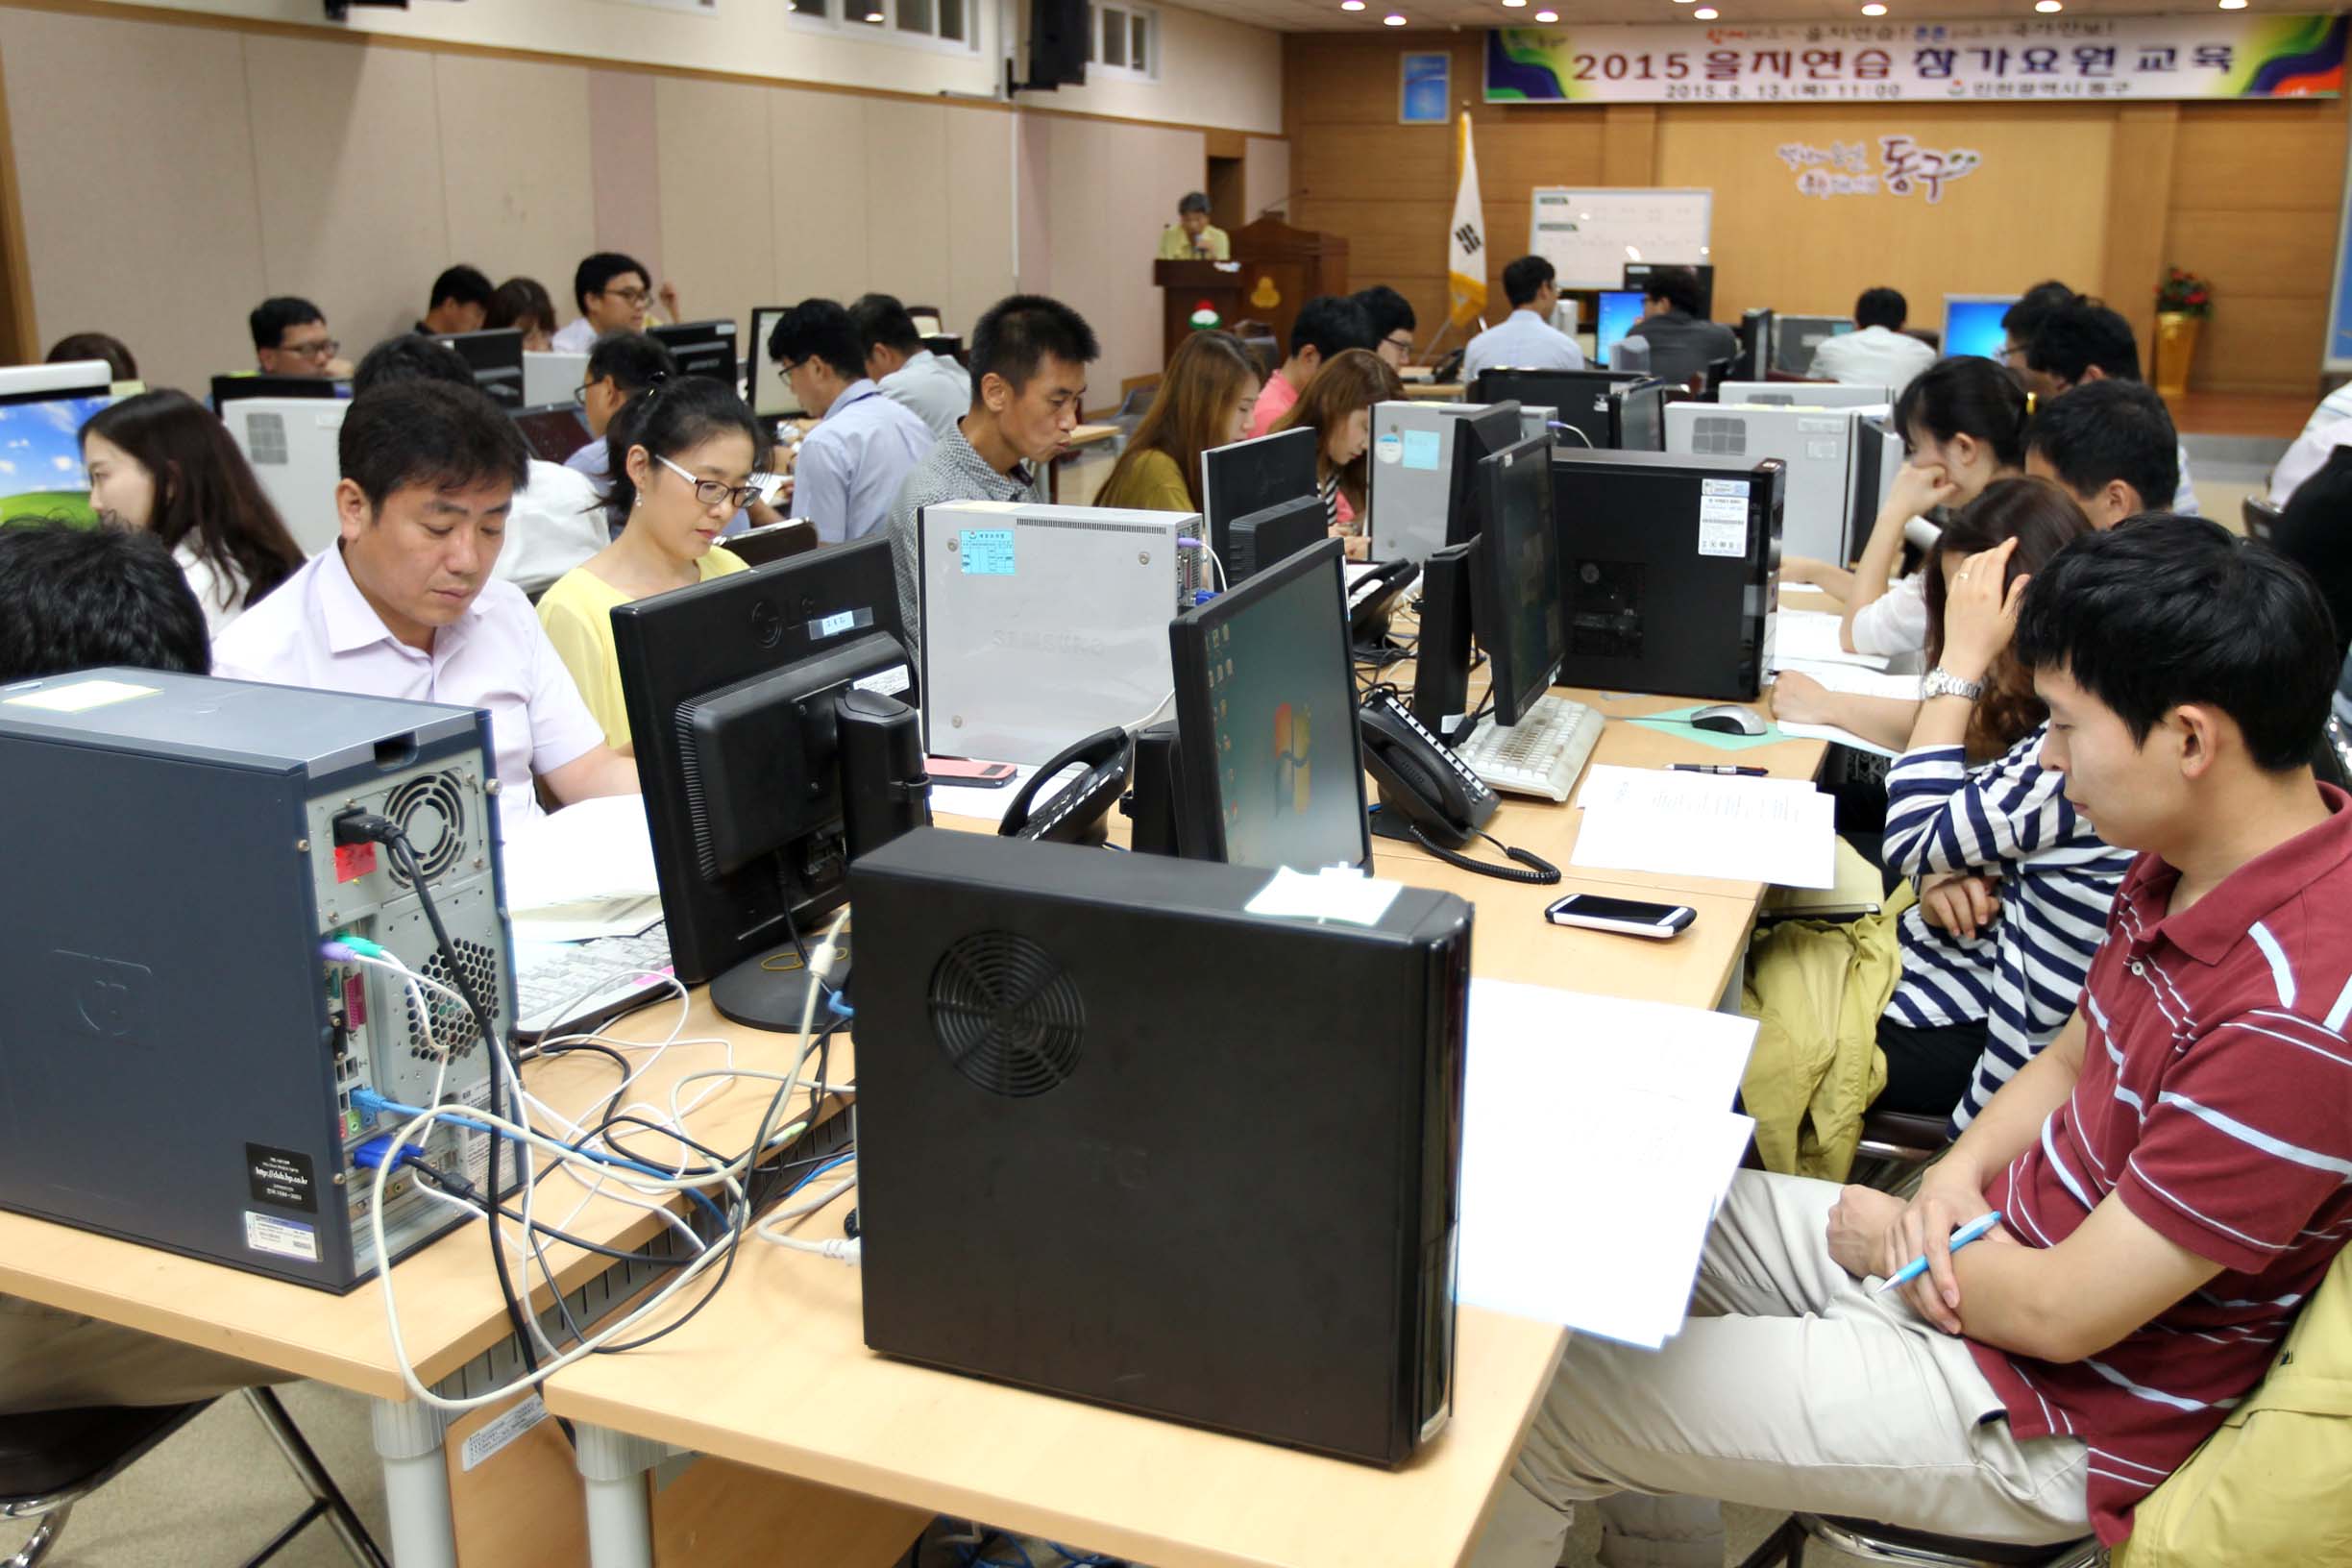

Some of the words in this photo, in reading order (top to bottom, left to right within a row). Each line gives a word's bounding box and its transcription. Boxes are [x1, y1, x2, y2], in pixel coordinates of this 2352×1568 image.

[1572, 52, 1690, 80] 2015
[1704, 47, 1892, 81] 을지연습
[1913, 44, 2117, 79] 참가요원
[2135, 43, 2236, 74] 교육
[1880, 136, 1969, 201] 동구
